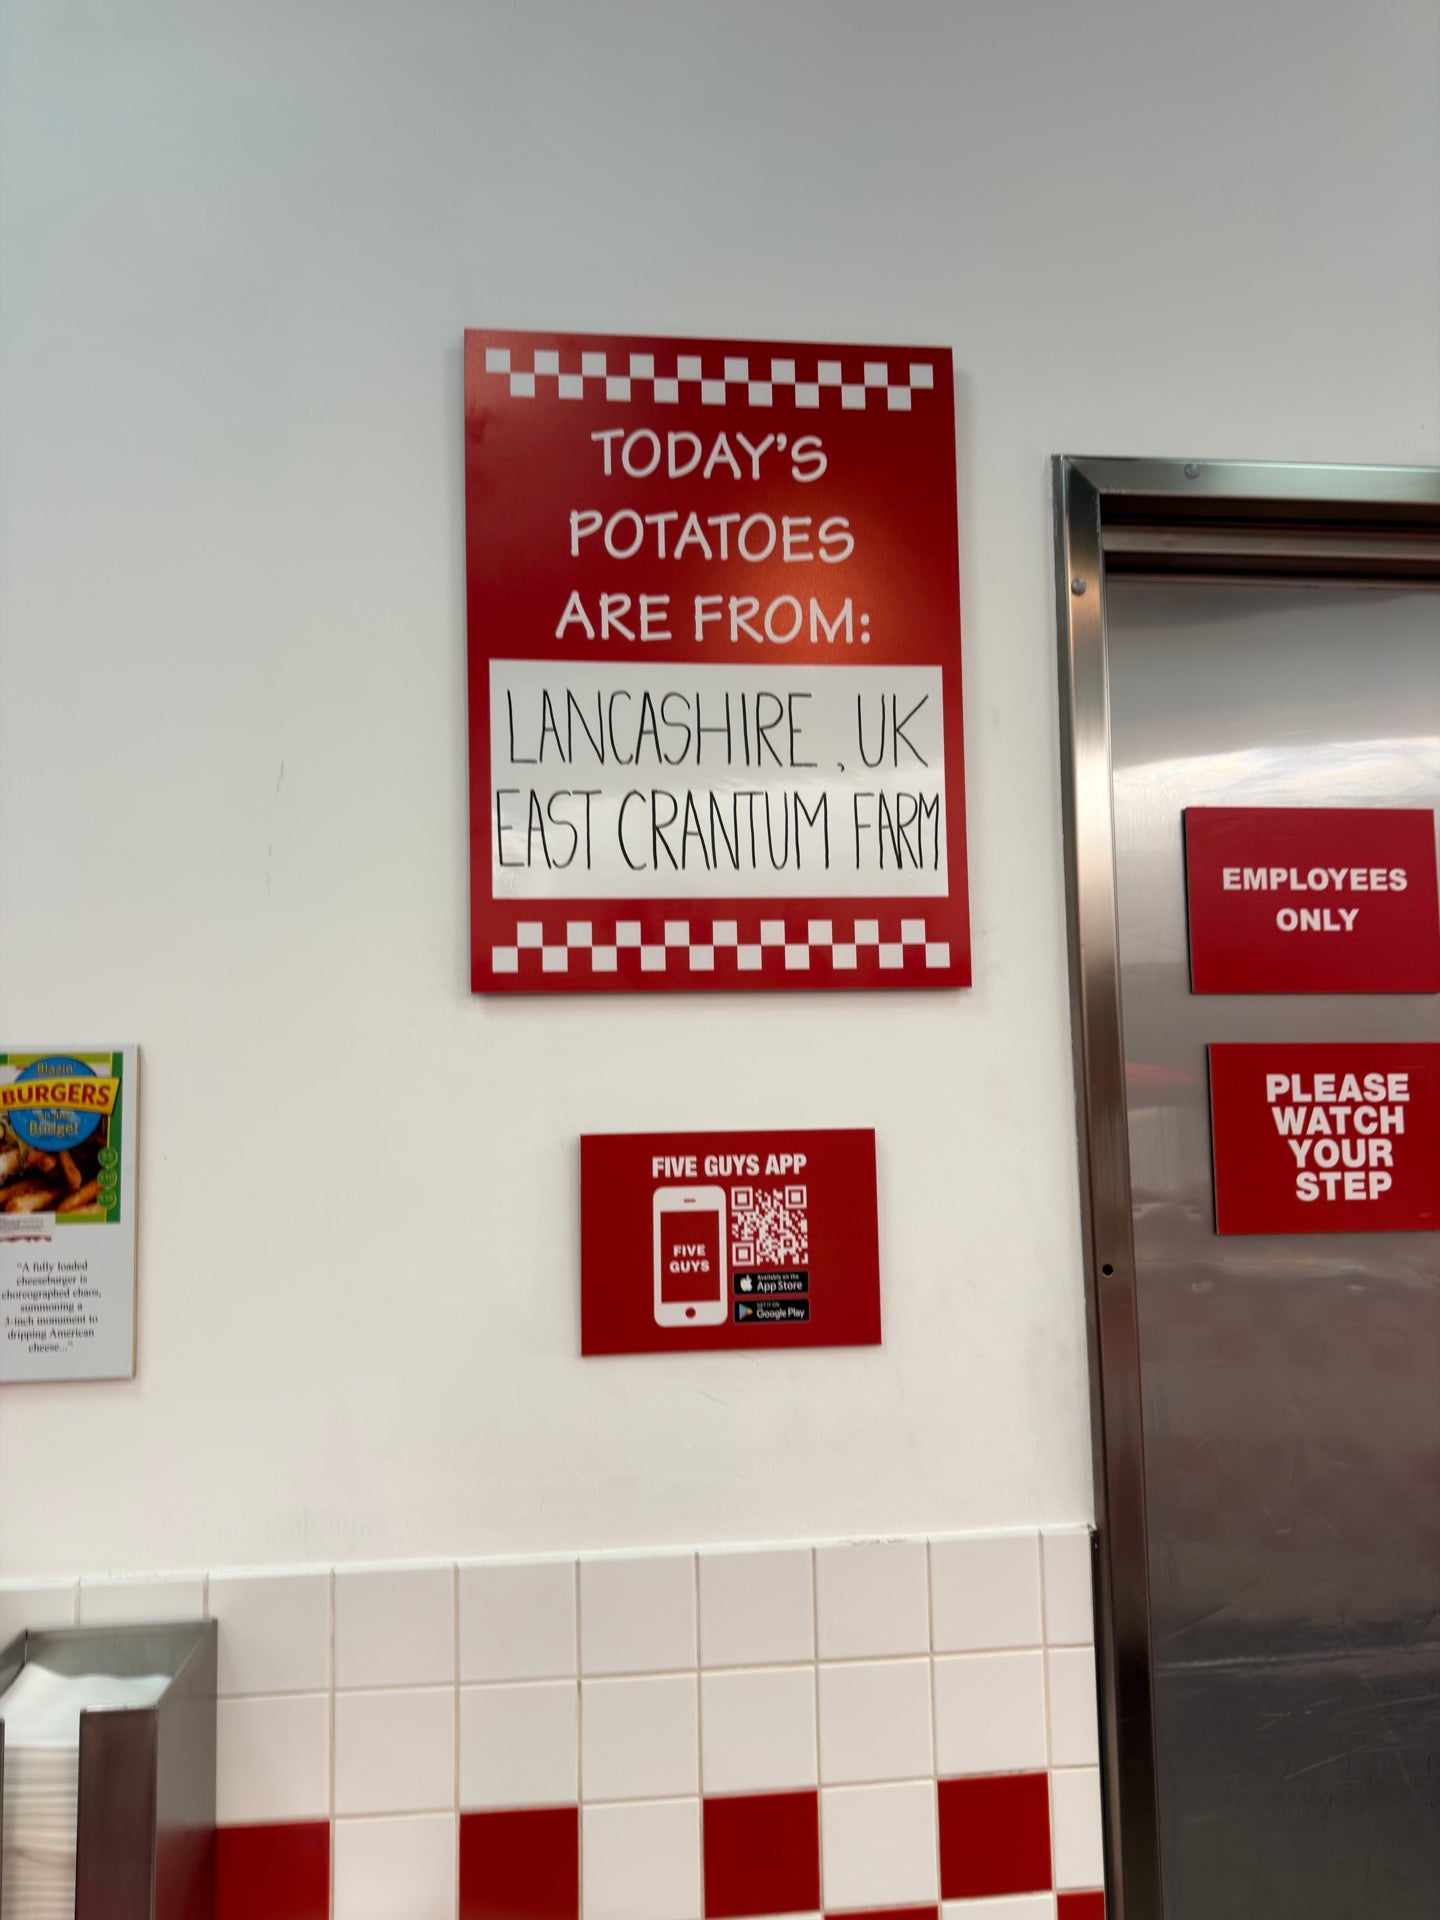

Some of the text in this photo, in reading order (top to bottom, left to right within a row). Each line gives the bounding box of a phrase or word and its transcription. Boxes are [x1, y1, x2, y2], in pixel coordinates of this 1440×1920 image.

[590, 427, 829, 483] TODAY'S
[568, 507, 856, 565] POTATOES
[555, 589, 871, 645] ARE FROM:
[855, 692, 930, 769] UK
[495, 788, 941, 872] EAST CRANTUM FARM
[1221, 867, 1408, 892] EMPLOYEES
[1275, 908, 1360, 932] ONLY
[1, 1082, 112, 1108] BURGERS
[1265, 1072, 1411, 1103] PLEASE
[28, 1120, 79, 1138] Budget
[1272, 1105, 1406, 1136] WATCH
[651, 1152, 808, 1179] FIVE GUYS APP
[1288, 1138, 1395, 1169] YOUR
[1295, 1170, 1393, 1202] STEP
[673, 1243, 706, 1257] FIVE
[33, 1261, 54, 1275] fully
[57, 1259, 88, 1272] loaded
[669, 1259, 710, 1274] GUYS
[16, 1274, 88, 1287] cheeseburger is
[757, 1279, 803, 1294] App Store
[1, 1287, 102, 1301] choreographed chaos,
[20, 1302, 83, 1314] summoning a
[756, 1306, 805, 1321] Google Play
[4, 1314, 99, 1328] 3-inch monument to
[7, 1327, 95, 1342] dripping American
